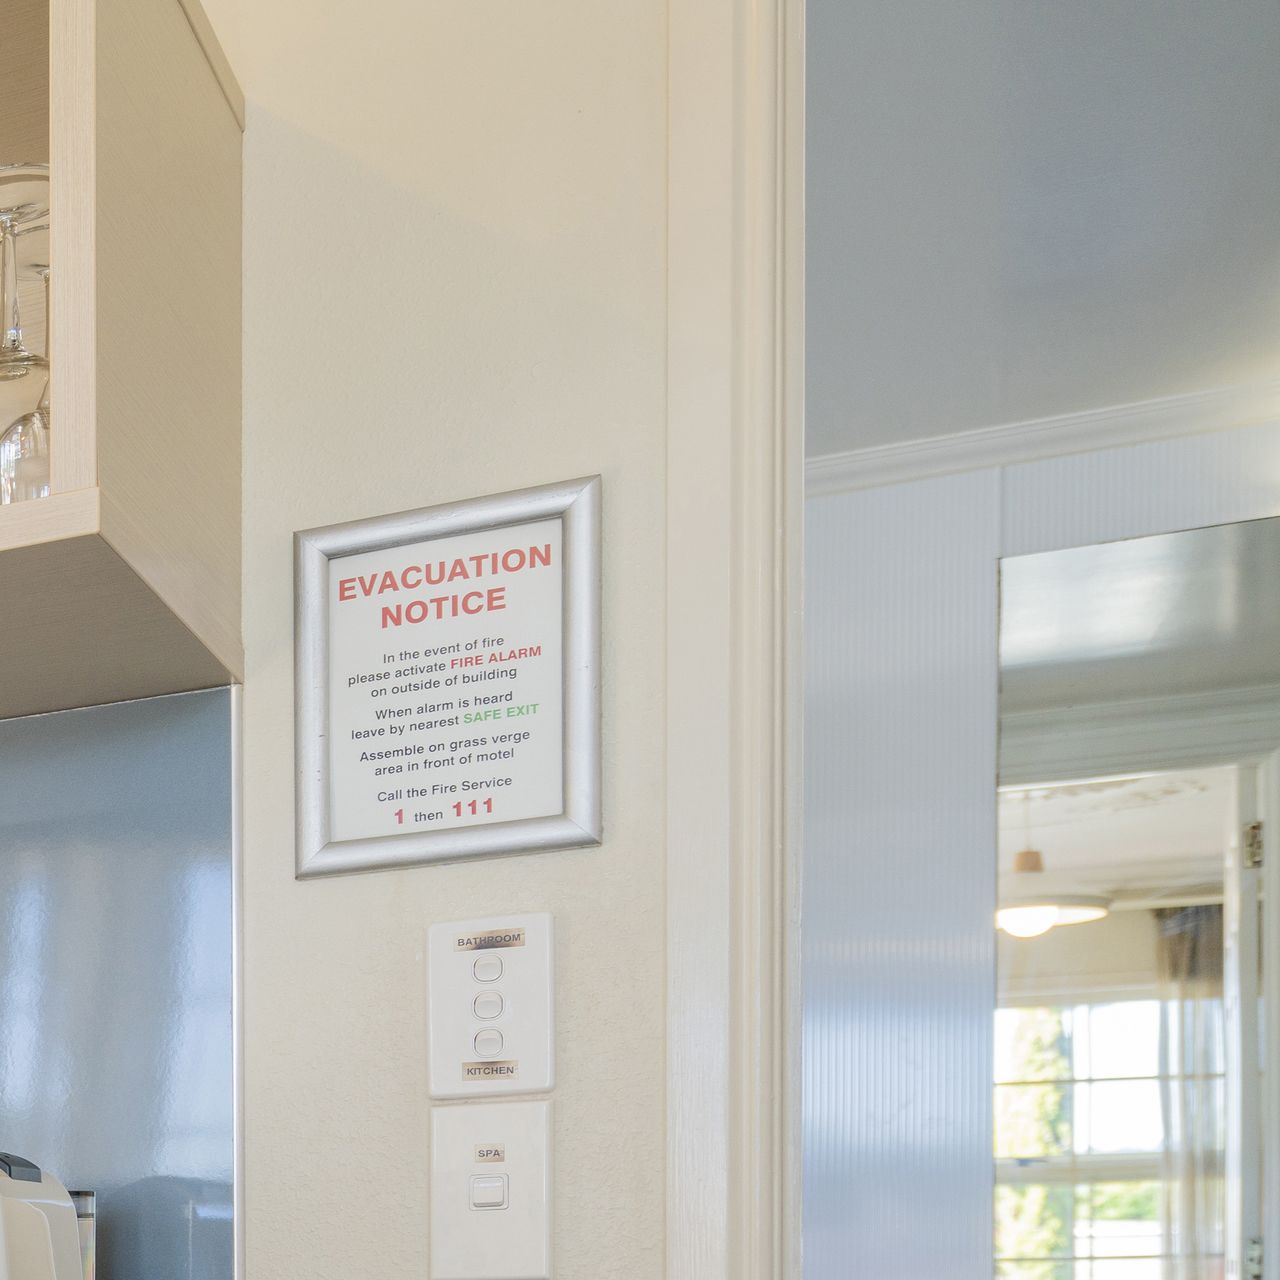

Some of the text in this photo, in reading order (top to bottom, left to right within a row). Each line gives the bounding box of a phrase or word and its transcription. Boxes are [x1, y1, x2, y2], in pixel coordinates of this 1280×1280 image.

[339, 544, 551, 601] EVACUATION
[381, 586, 506, 629] NOTICE
[383, 637, 505, 664] In the event of fire
[348, 645, 542, 687] please activate FIRE ALARM
[371, 667, 517, 698] on outside of building
[375, 691, 513, 720] When alarm is heard
[351, 703, 540, 740] leave by nearest SAFE EXIT
[359, 730, 531, 762] Assemble on grass verge
[374, 748, 515, 776] area in front of motel
[377, 776, 512, 802] Call the Fire Service
[394, 808, 404, 825] 1
[414, 810, 443, 822] then
[457, 932, 522, 947] BATHROOM
[466, 1065, 515, 1076] KITCHEN
[478, 1149, 501, 1158] SPA
